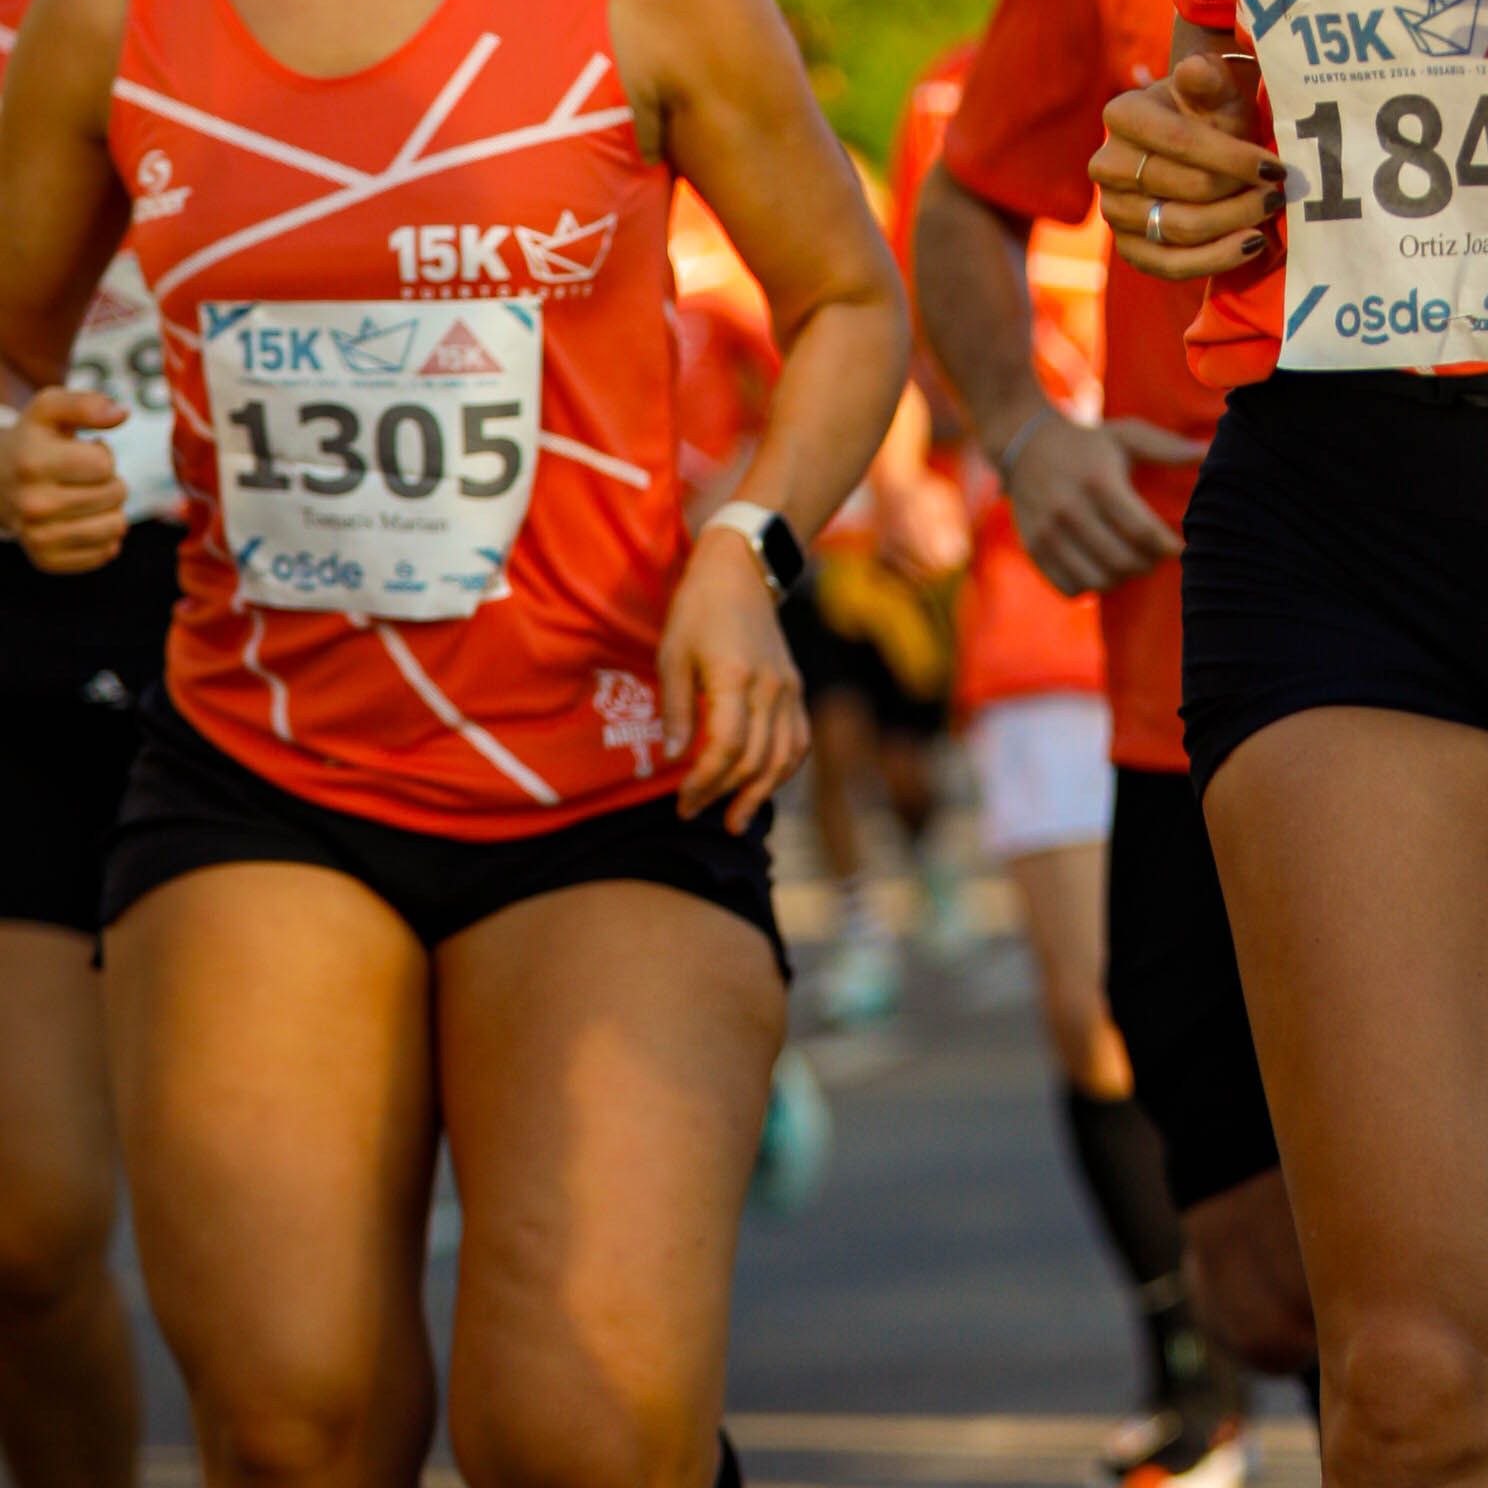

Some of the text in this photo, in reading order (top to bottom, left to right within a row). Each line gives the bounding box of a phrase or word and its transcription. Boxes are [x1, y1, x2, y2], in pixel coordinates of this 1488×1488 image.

[1290, 8, 1396, 66] 15K
[1303, 72, 1347, 85] PUERTO
[1349, 69, 1386, 81] NORTE
[388, 224, 512, 282] 15K
[1399, 233, 1458, 258] Ortiz
[1335, 287, 1451, 340] osde
[237, 327, 324, 372] 15K
[228, 398, 523, 499] 1305
[272, 548, 363, 590] osde
